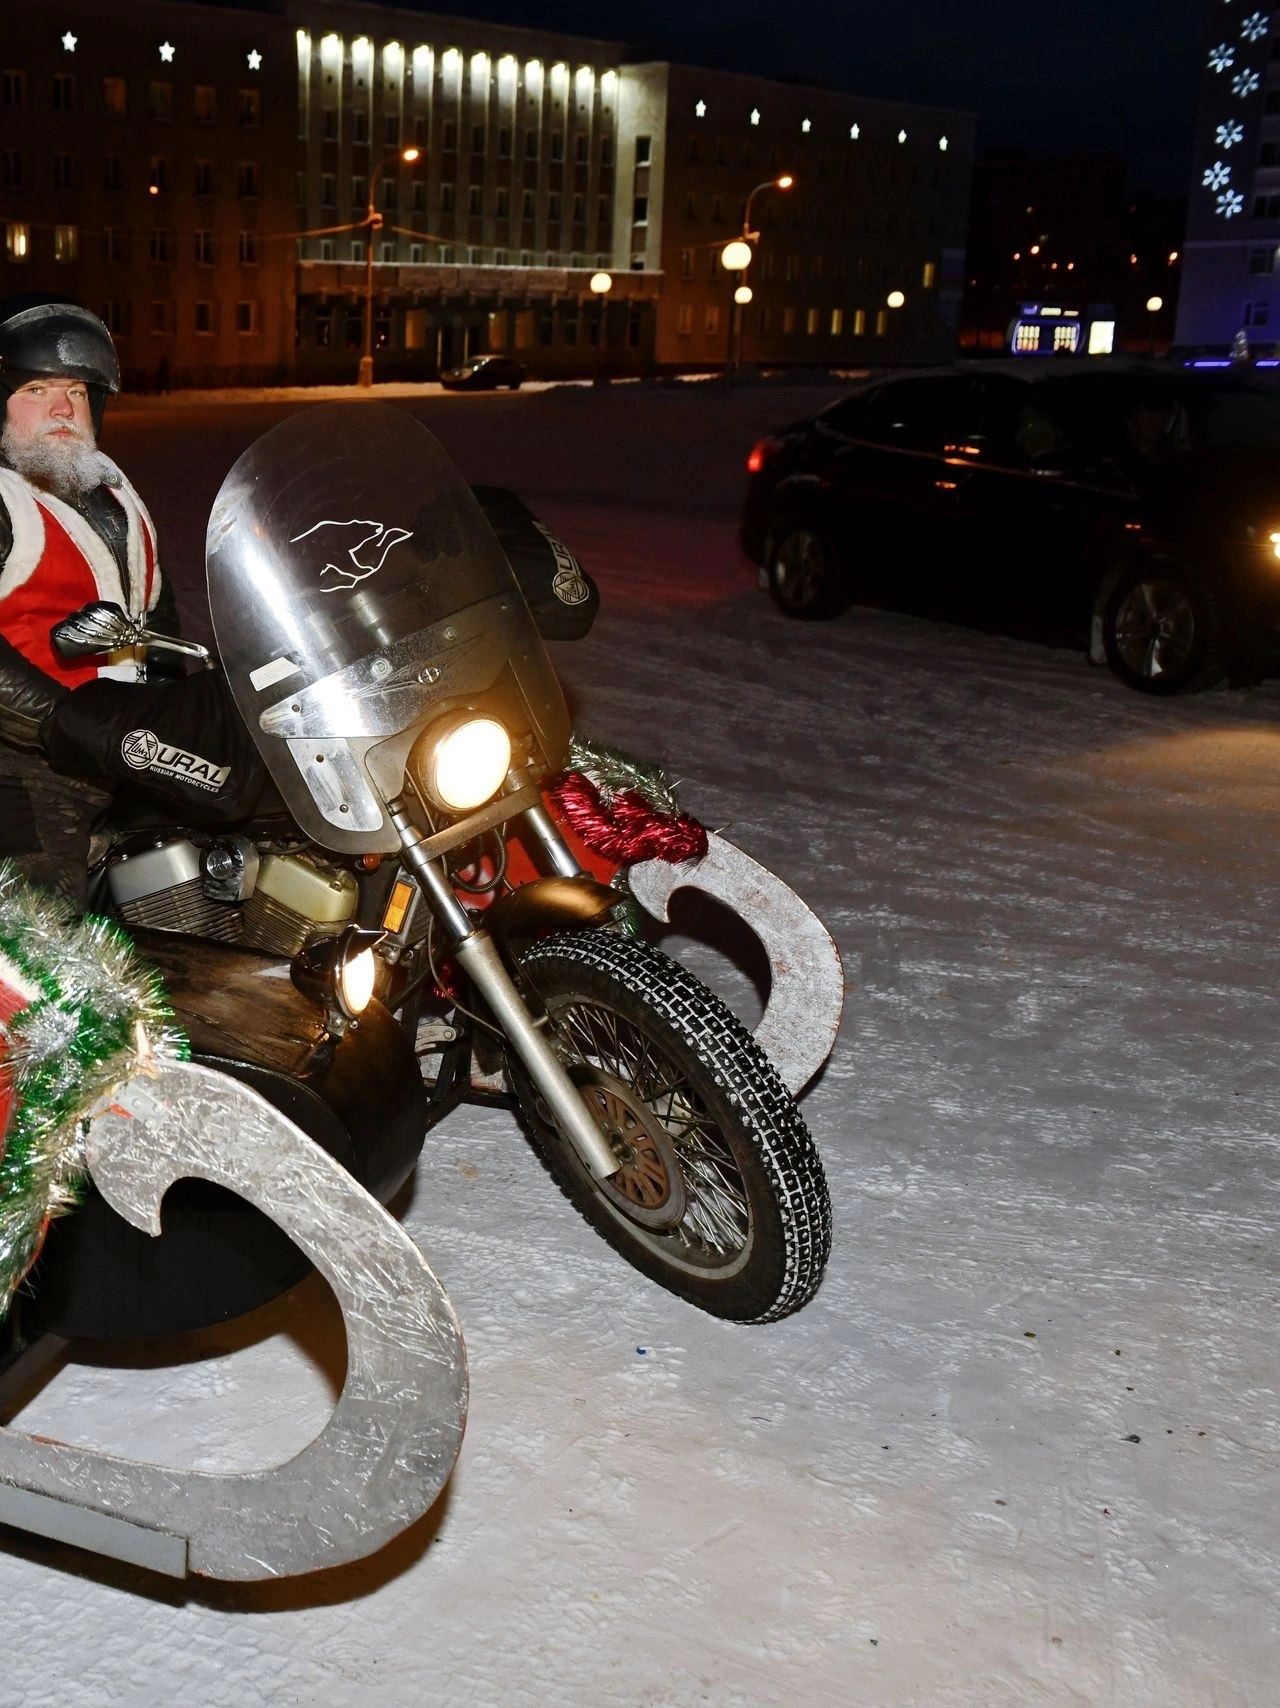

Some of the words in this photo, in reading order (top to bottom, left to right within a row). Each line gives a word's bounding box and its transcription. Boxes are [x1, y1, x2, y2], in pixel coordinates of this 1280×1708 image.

[149, 765, 174, 777] RUSSIAN
[174, 773, 220, 793] MOTORCYCLES
[157, 747, 222, 785] URAL
